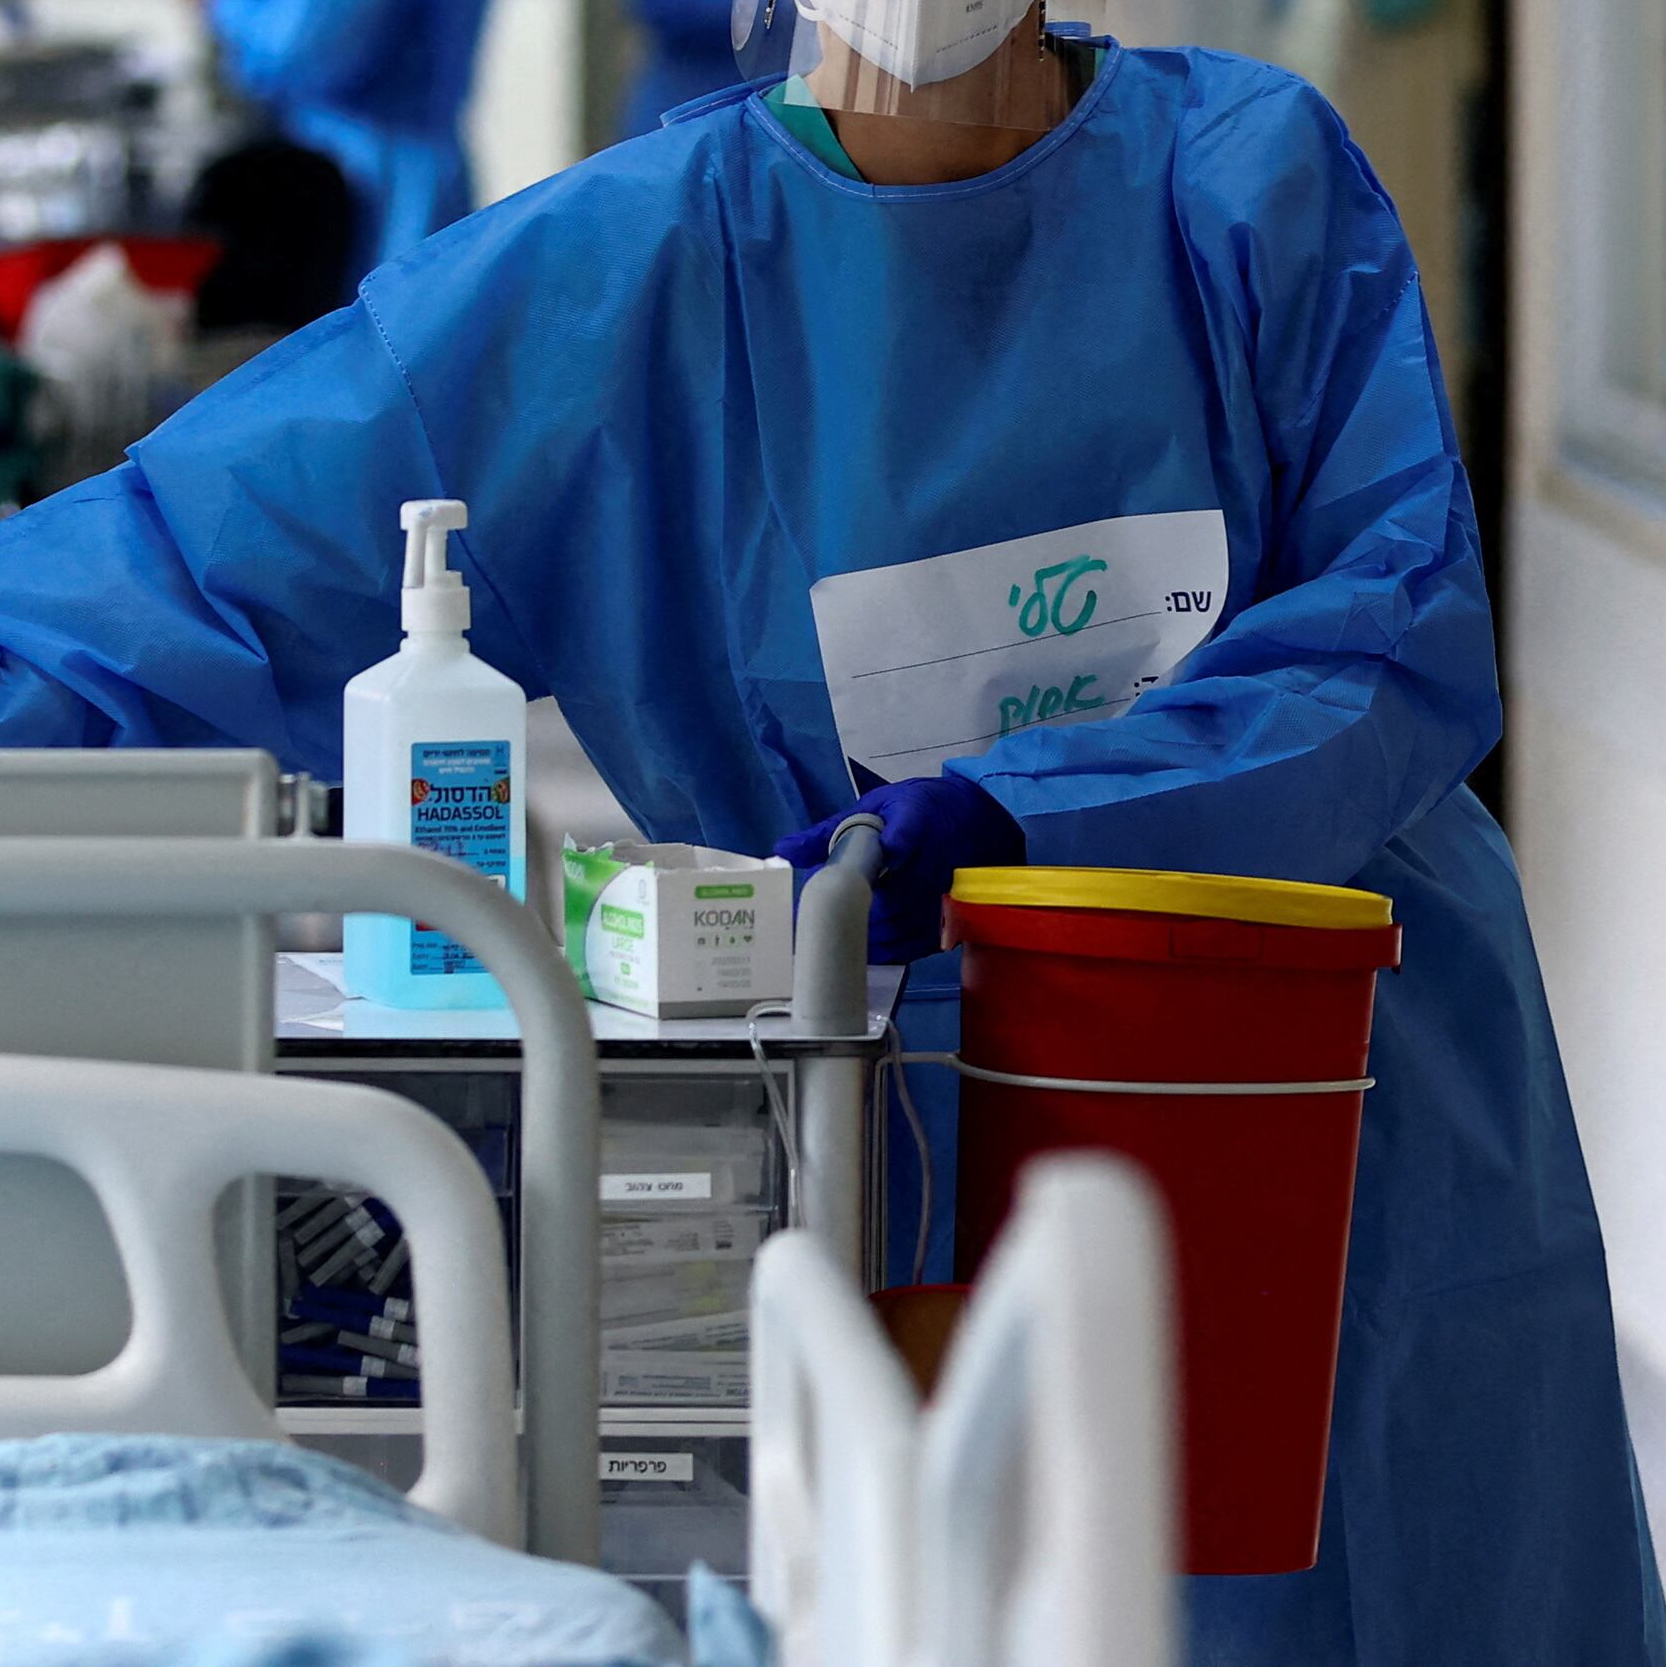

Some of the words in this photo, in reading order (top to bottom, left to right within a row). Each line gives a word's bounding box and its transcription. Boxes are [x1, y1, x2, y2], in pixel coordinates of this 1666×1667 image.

[1165, 590, 1212, 613] שם:
[429, 782, 492, 804] הדסול
[417, 804, 505, 822] HADASSOL
[694, 909, 755, 927] KODAN
[608, 1460, 667, 1473] פרפריות
